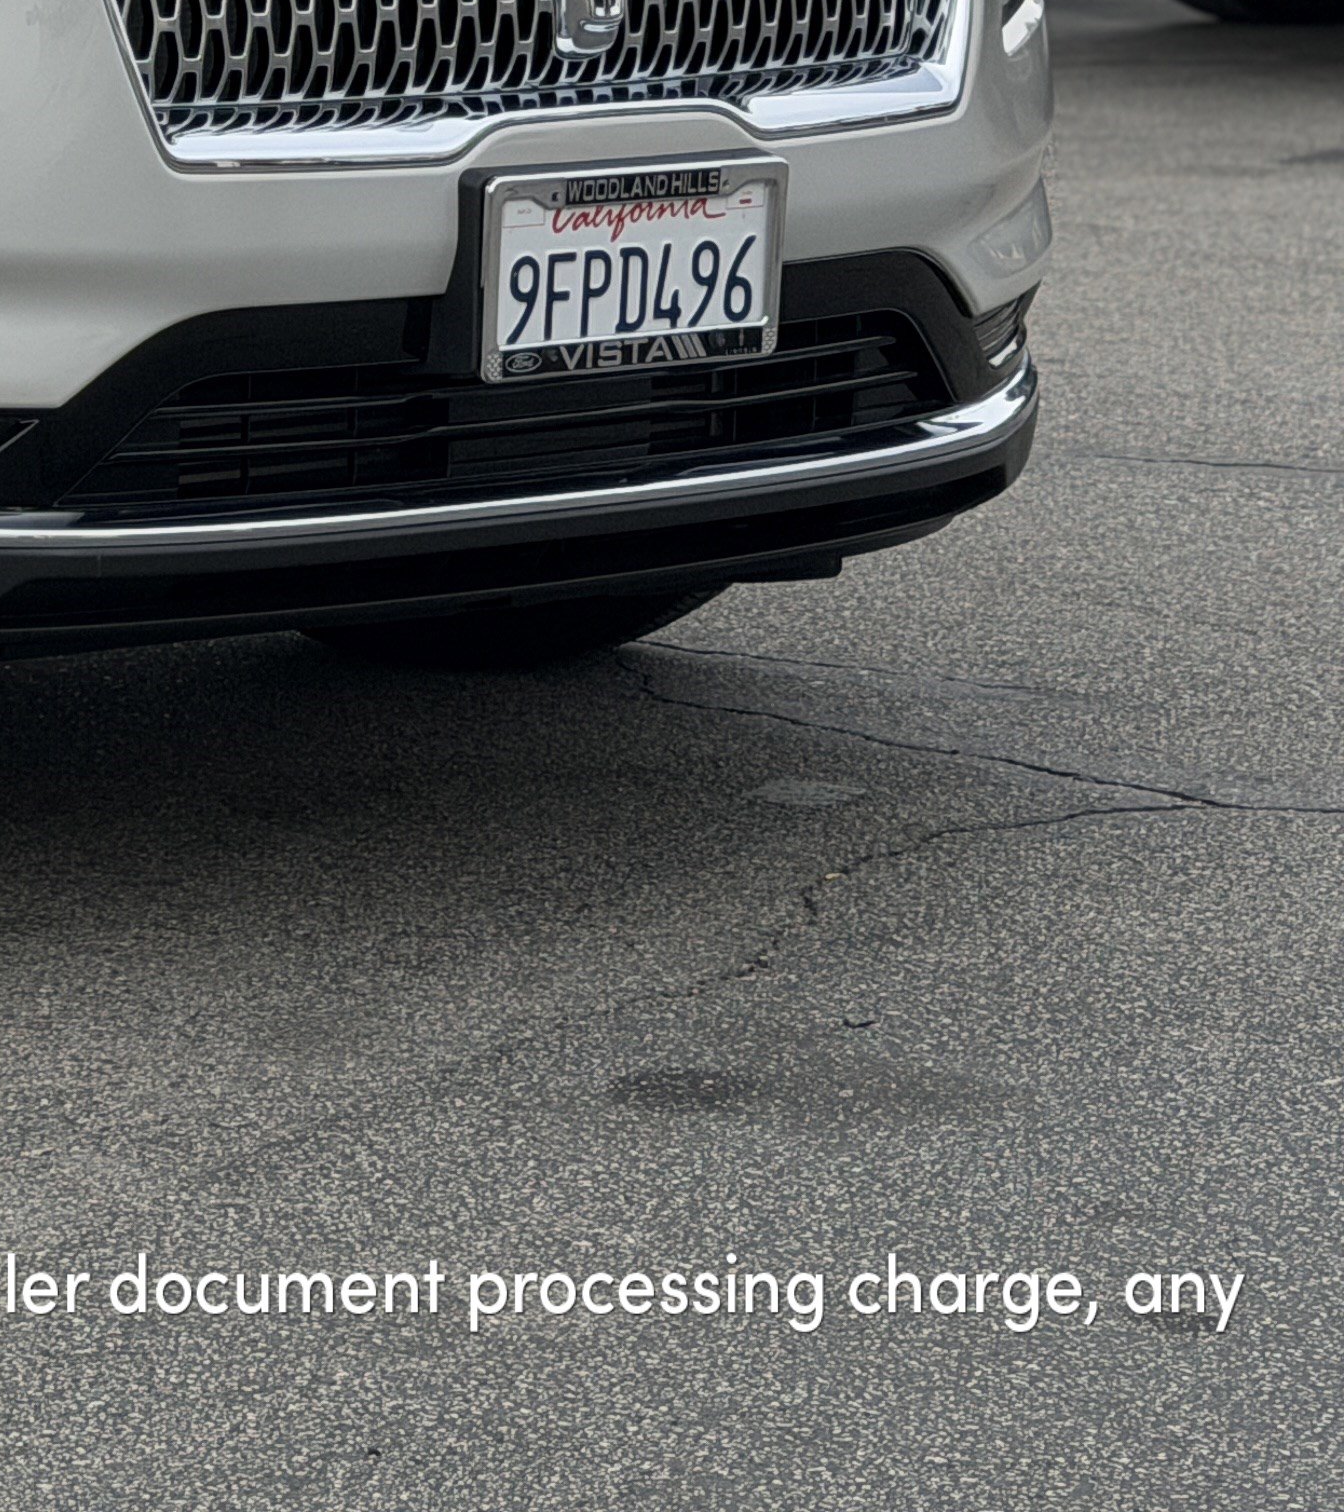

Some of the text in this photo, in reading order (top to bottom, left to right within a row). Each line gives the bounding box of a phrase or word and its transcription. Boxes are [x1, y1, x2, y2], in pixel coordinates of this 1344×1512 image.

[567, 171, 720, 203] WOODLAND HILLS
[552, 198, 726, 242] California
[505, 235, 757, 345] 9FPD496
[559, 338, 673, 371] VISTA
